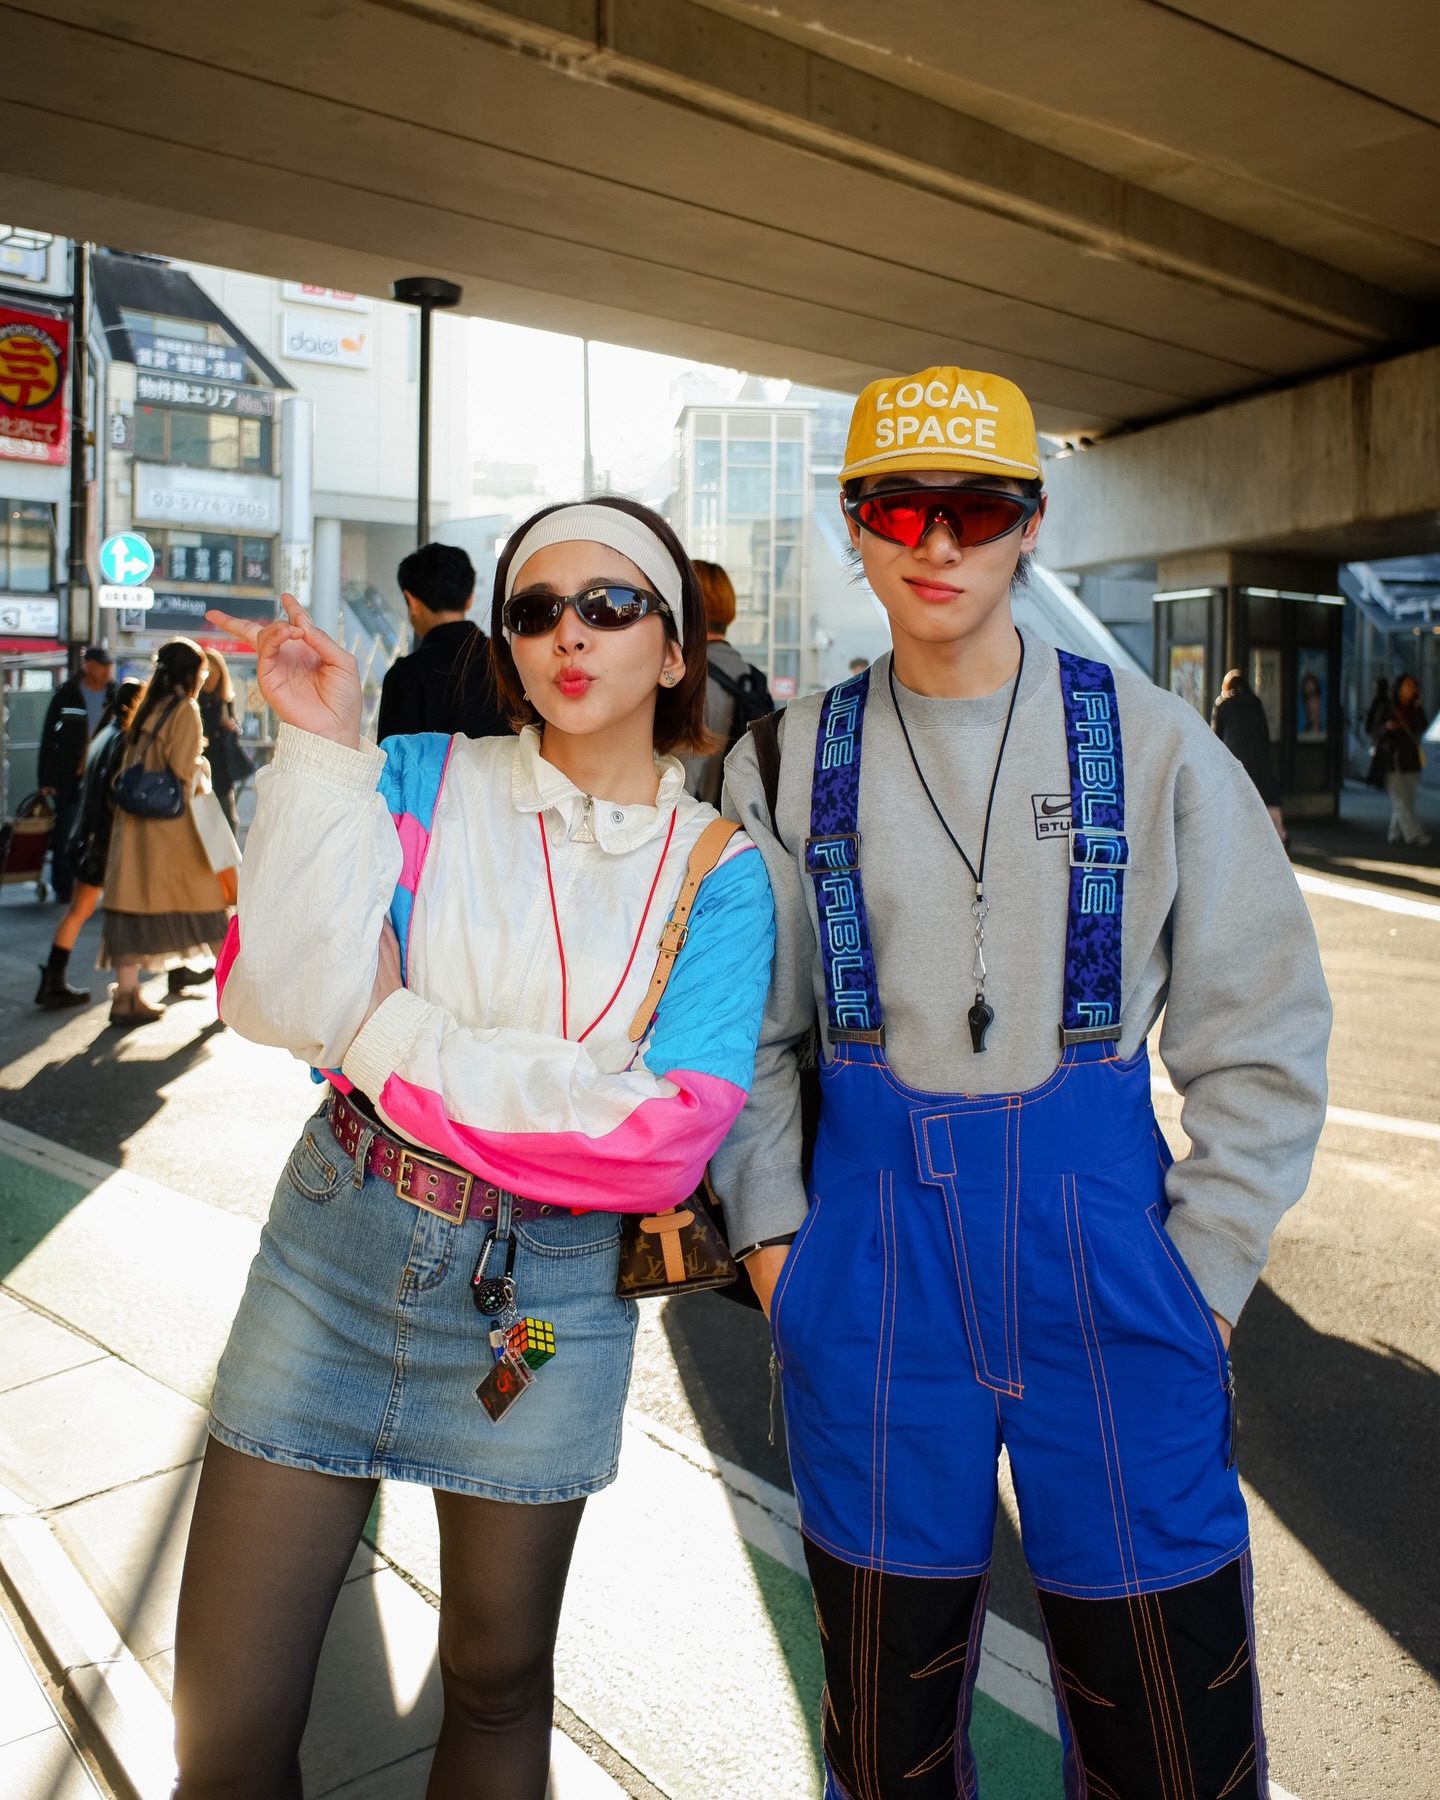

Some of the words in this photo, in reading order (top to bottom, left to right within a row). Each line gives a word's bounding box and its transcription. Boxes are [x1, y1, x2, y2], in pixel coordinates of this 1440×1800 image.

[288, 331, 338, 355] daiei
[876, 381, 998, 413] LOCAL
[875, 416, 996, 449] SPACE
[1039, 821, 1072, 832] STU
